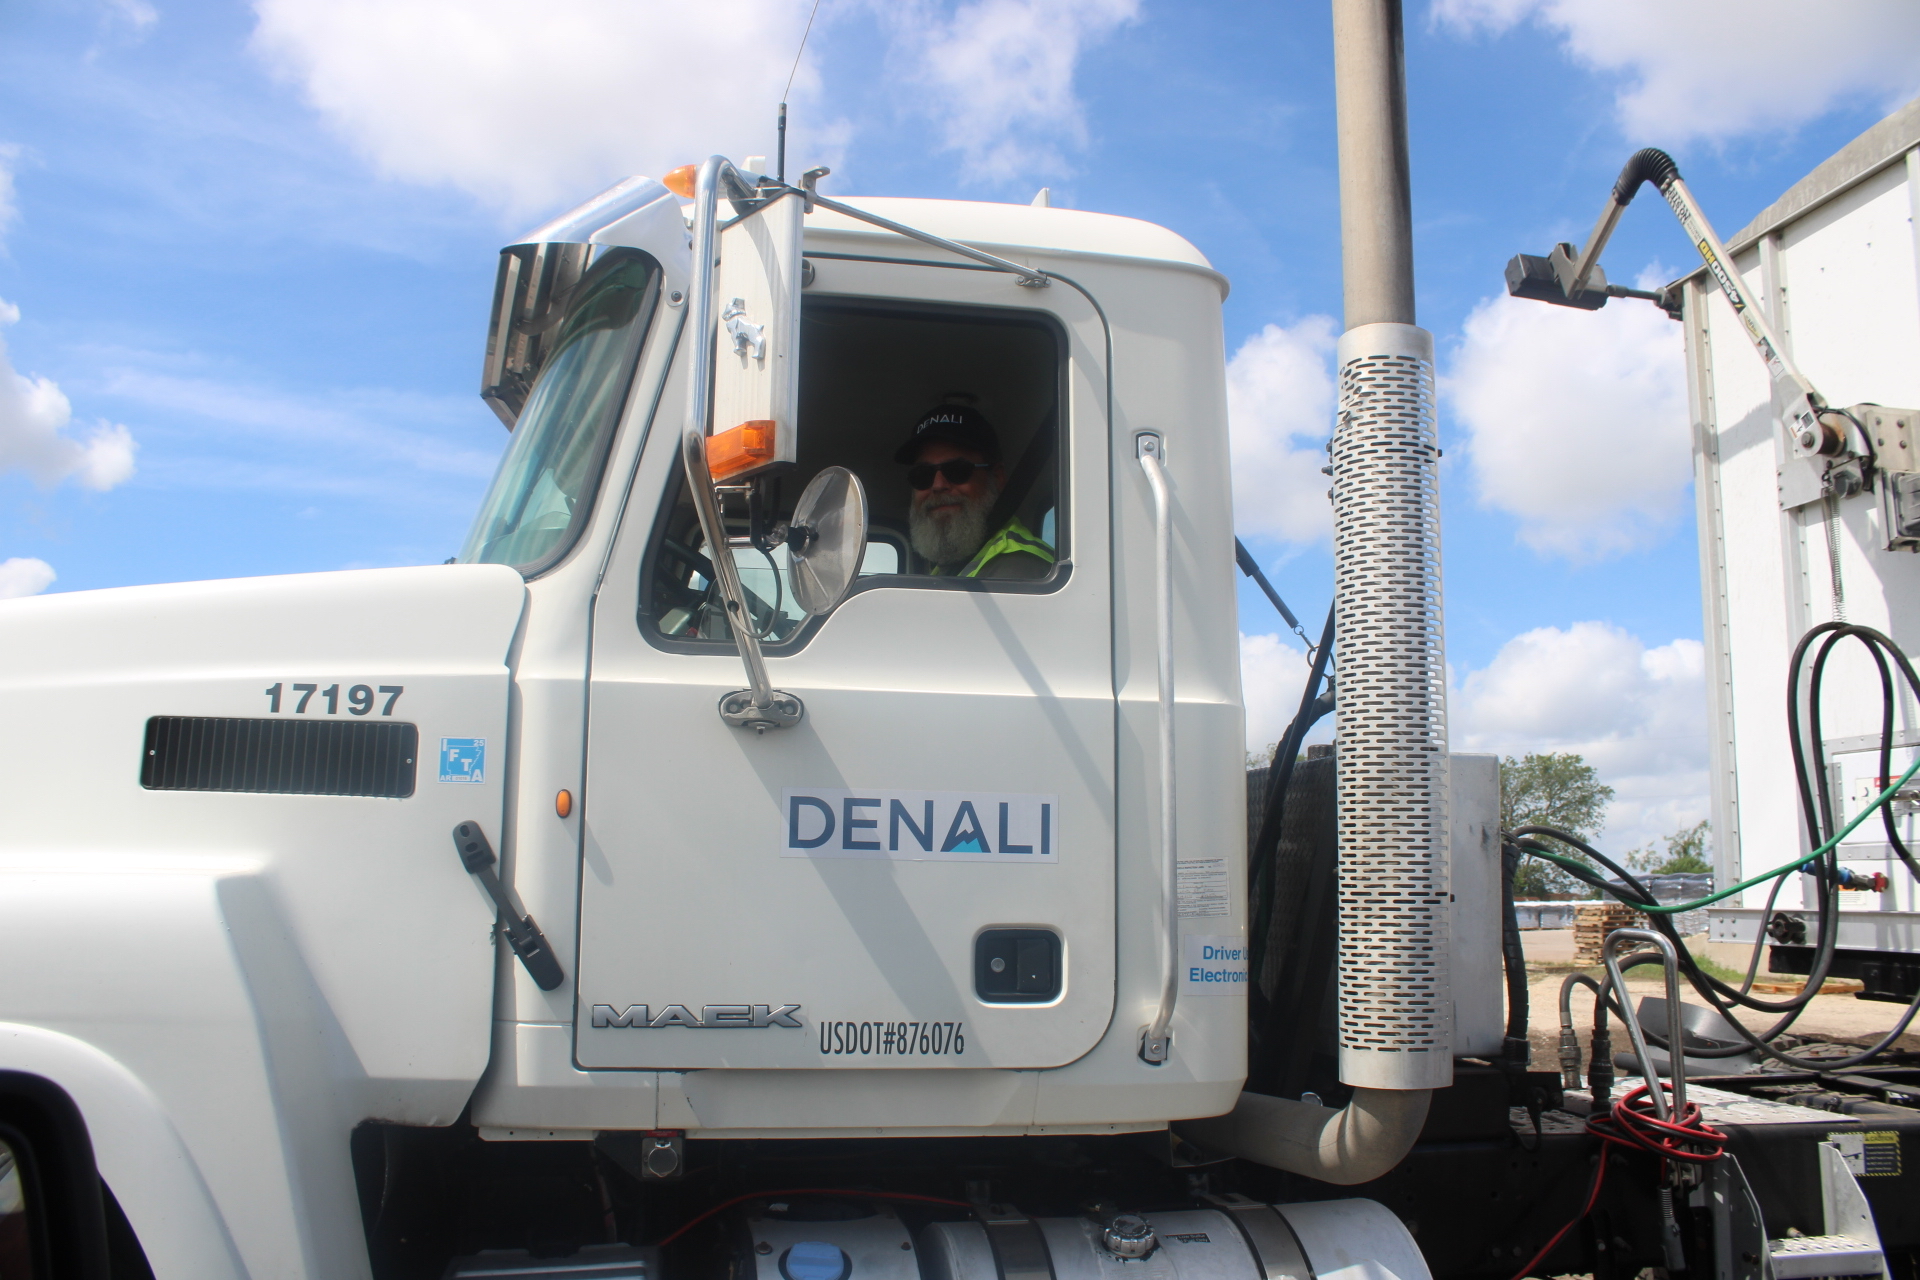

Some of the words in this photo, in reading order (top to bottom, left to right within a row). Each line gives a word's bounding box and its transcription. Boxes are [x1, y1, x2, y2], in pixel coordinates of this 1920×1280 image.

[1698, 240, 1741, 305] 4500HD
[917, 414, 963, 434] DENALI
[265, 682, 405, 717] 17197
[789, 795, 1051, 855] DENALI
[1203, 945, 1242, 960] Driver
[592, 1003, 803, 1029] MACK
[819, 1021, 966, 1055] USDOT#876076
